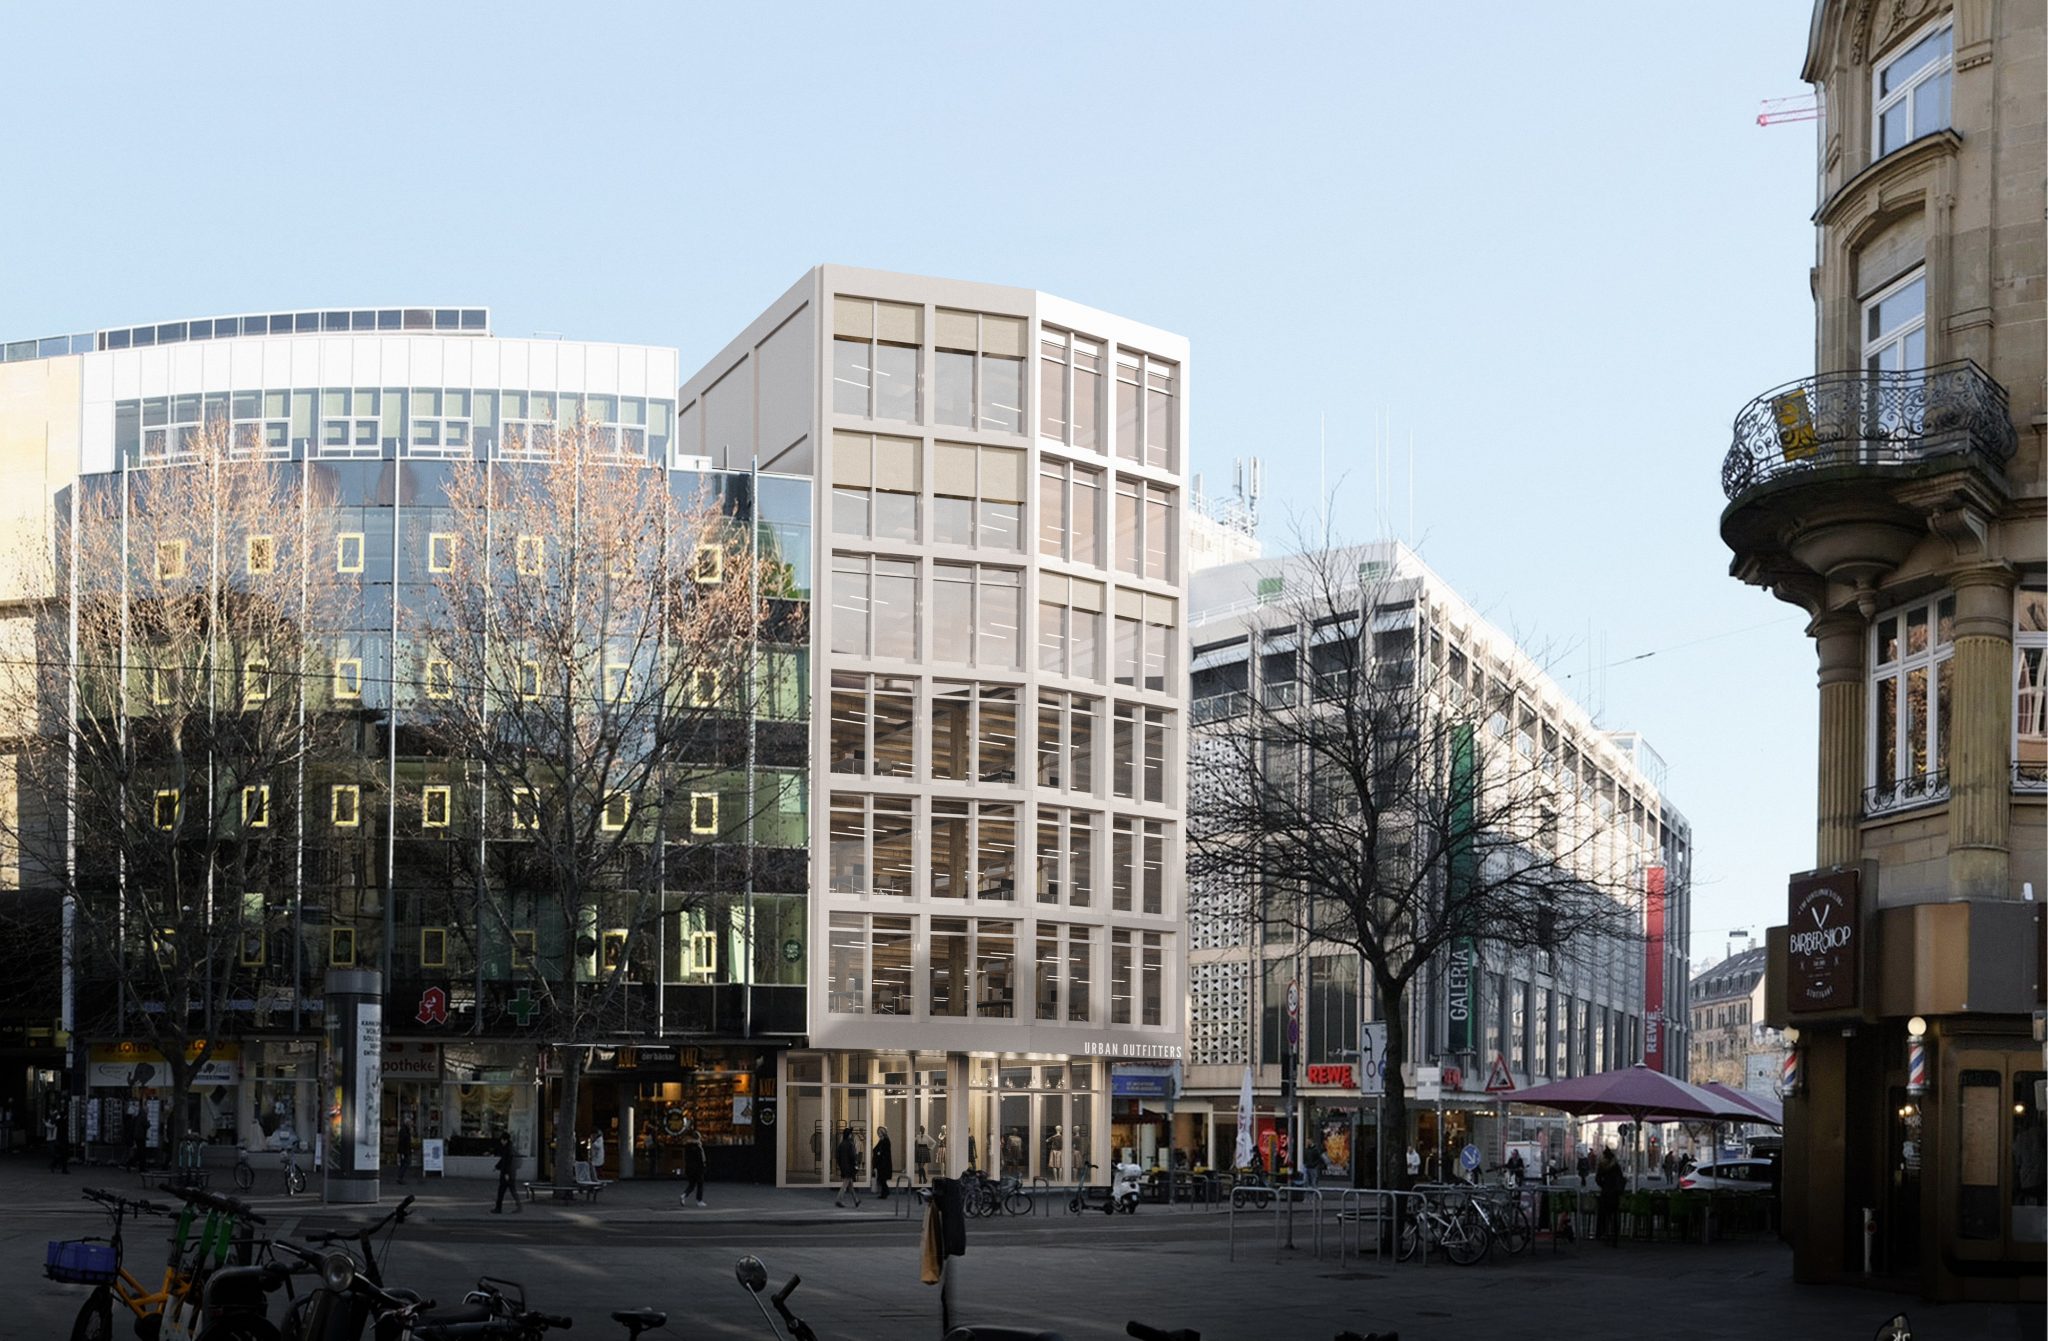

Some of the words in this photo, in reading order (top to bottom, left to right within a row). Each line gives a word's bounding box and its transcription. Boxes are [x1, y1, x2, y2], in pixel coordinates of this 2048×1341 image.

[1789, 925, 1852, 957] BARBERSHOP
[1450, 948, 1469, 1021] GALERIA
[1646, 1011, 1657, 1054] REWE
[1084, 1041, 1118, 1056] URBAN
[1123, 1043, 1182, 1058] OUTFITTERS
[1307, 1065, 1353, 1084] REWE
